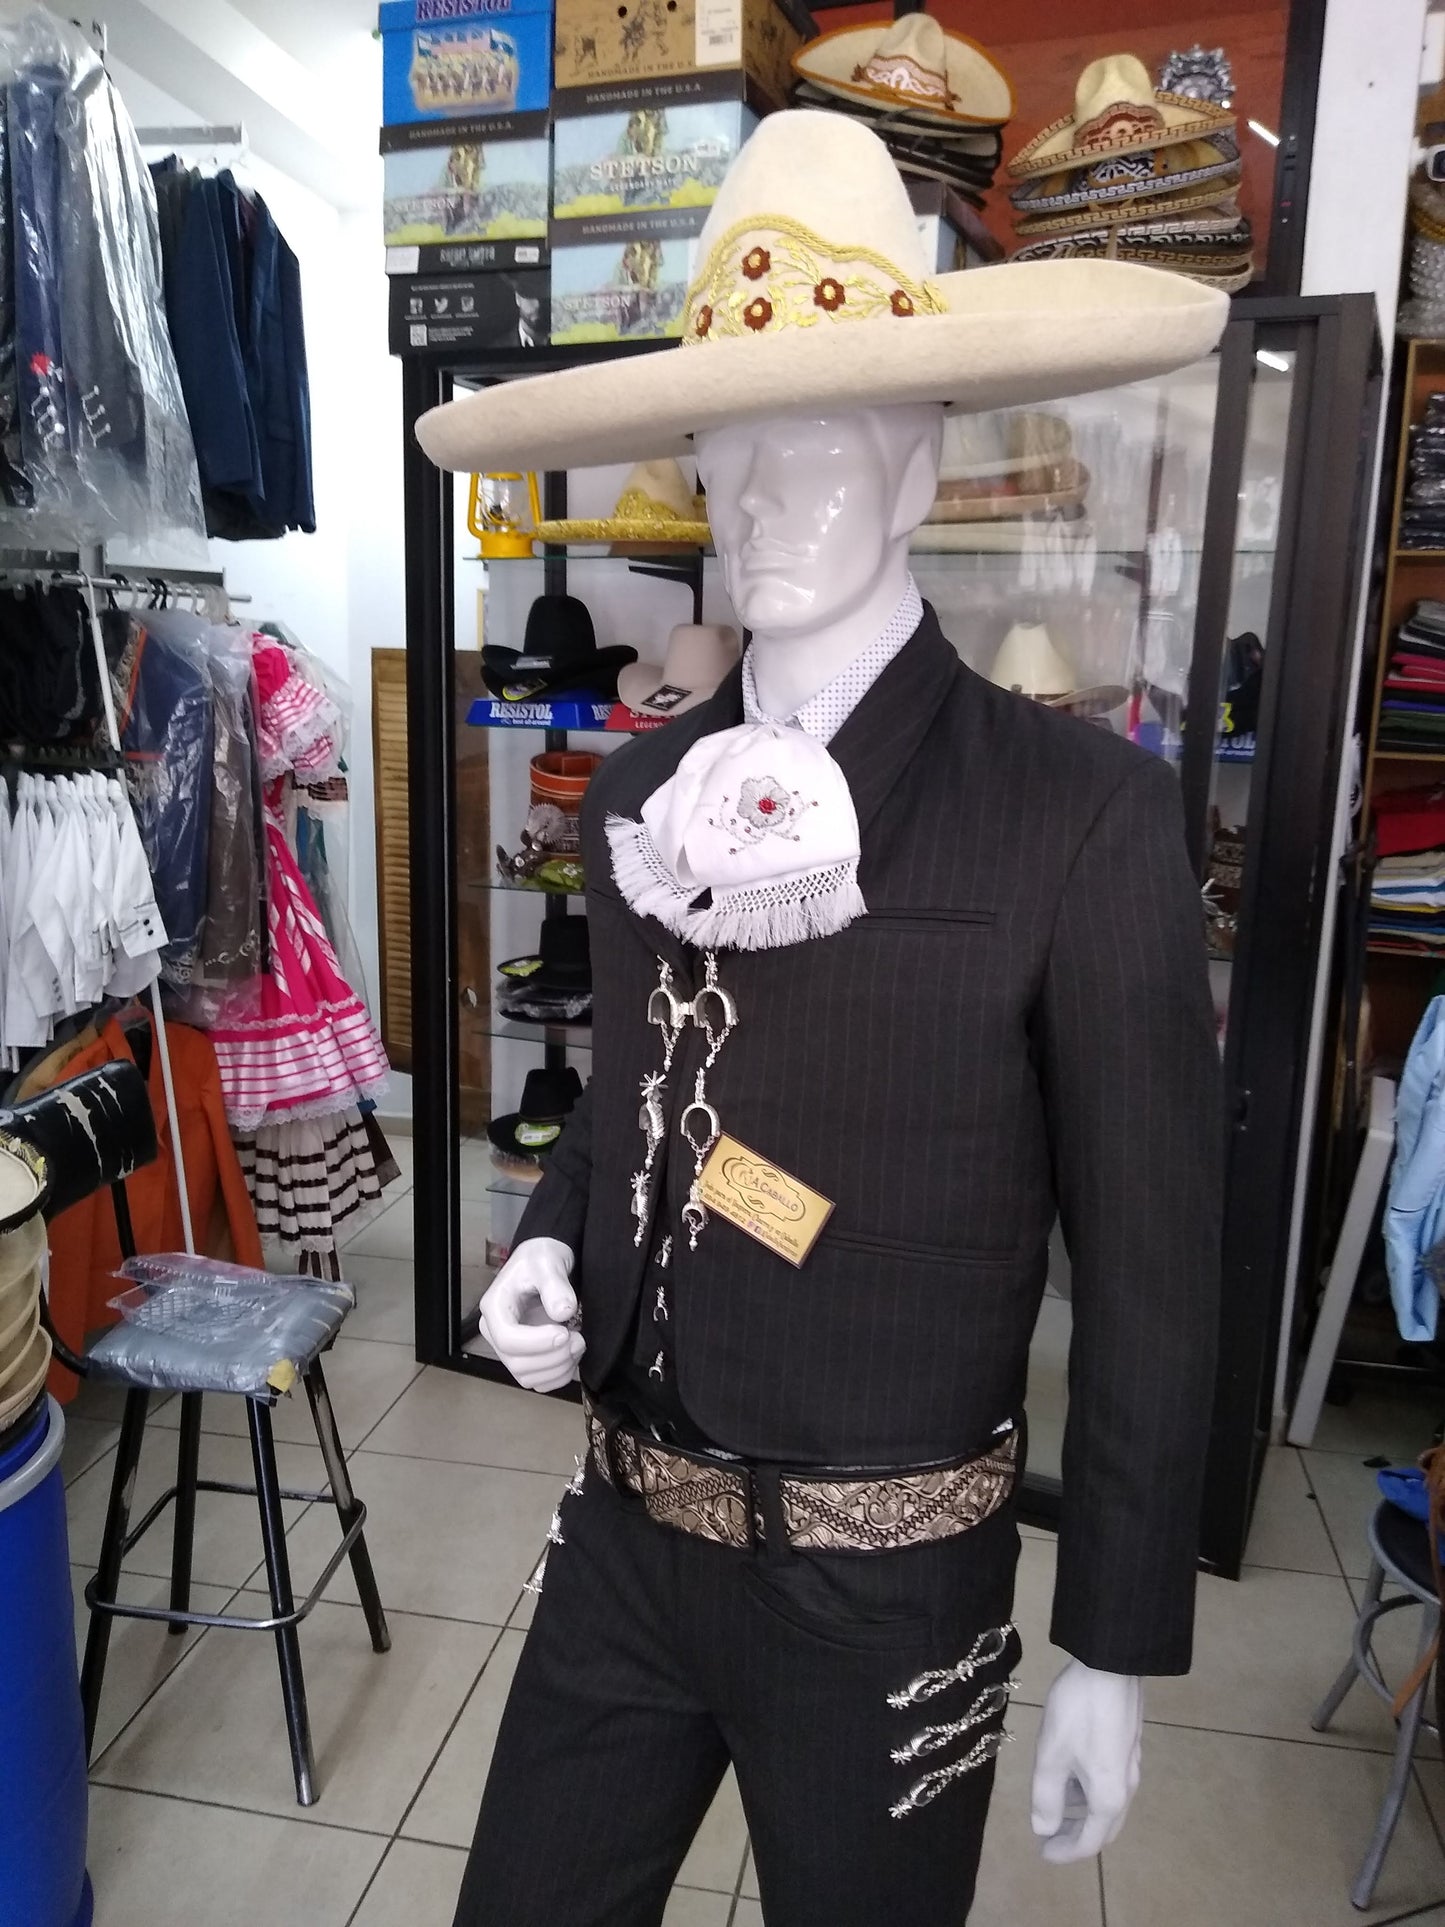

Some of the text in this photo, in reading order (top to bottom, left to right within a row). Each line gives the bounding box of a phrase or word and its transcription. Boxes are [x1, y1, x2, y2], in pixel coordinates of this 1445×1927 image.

[586, 88, 640, 104] HANDMADE
[641, 87, 653, 97] IN
[654, 85, 674, 96] THE
[458, 125, 469, 135] IN
[590, 153, 698, 181] STETSON
[582, 221, 635, 235] HANDMADE
[636, 220, 648, 231] IN
[650, 218, 668, 229] THE
[489, 702, 553, 720] RESISTOL
